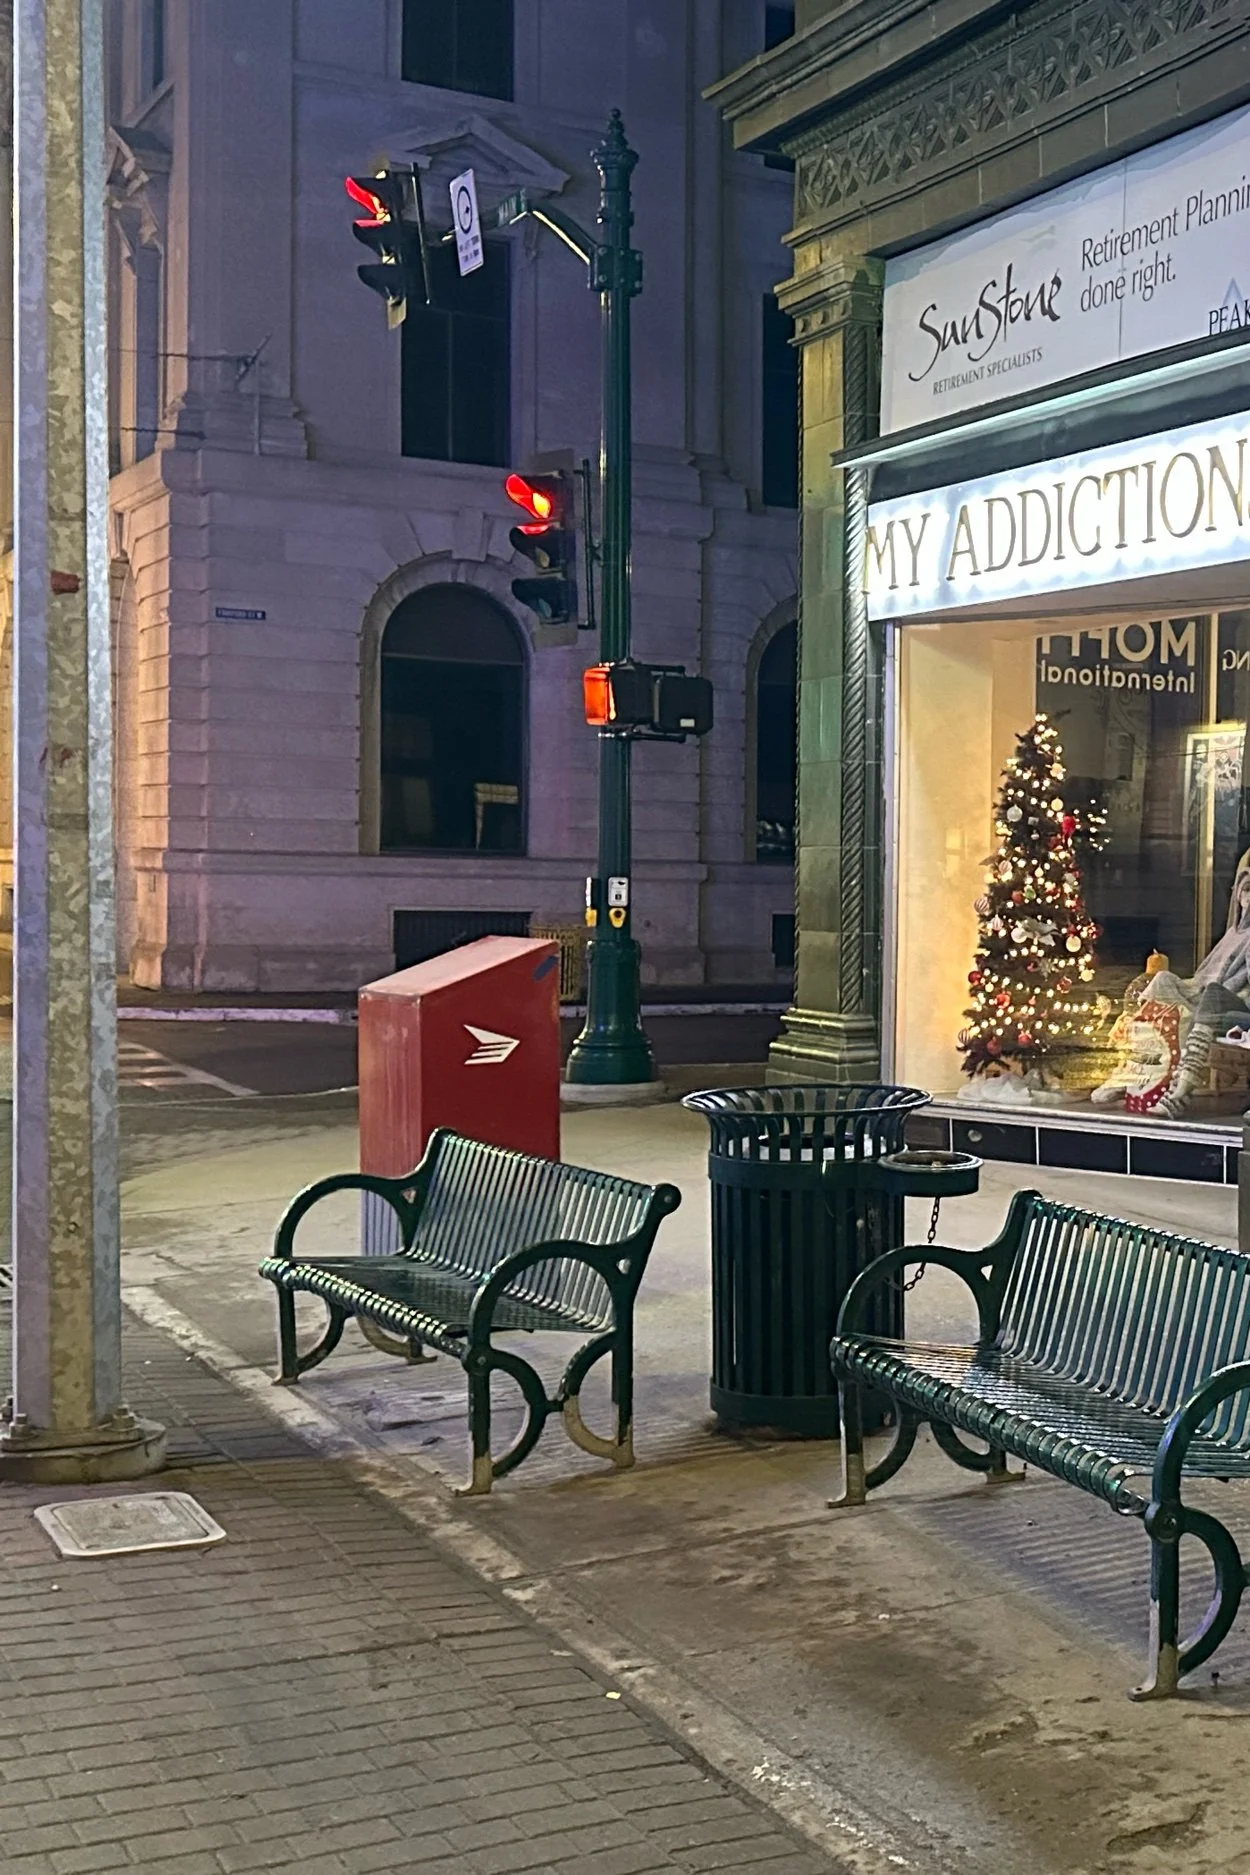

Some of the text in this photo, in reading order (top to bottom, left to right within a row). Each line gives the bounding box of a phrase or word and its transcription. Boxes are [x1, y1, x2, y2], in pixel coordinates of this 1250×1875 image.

[1081, 207, 1180, 271] Retirement
[1080, 250, 1176, 312] done right.
[908, 262, 1062, 382] SunStone
[932, 346, 1043, 396] RETIREMENT SPECIALISTS
[862, 512, 931, 596] MY
